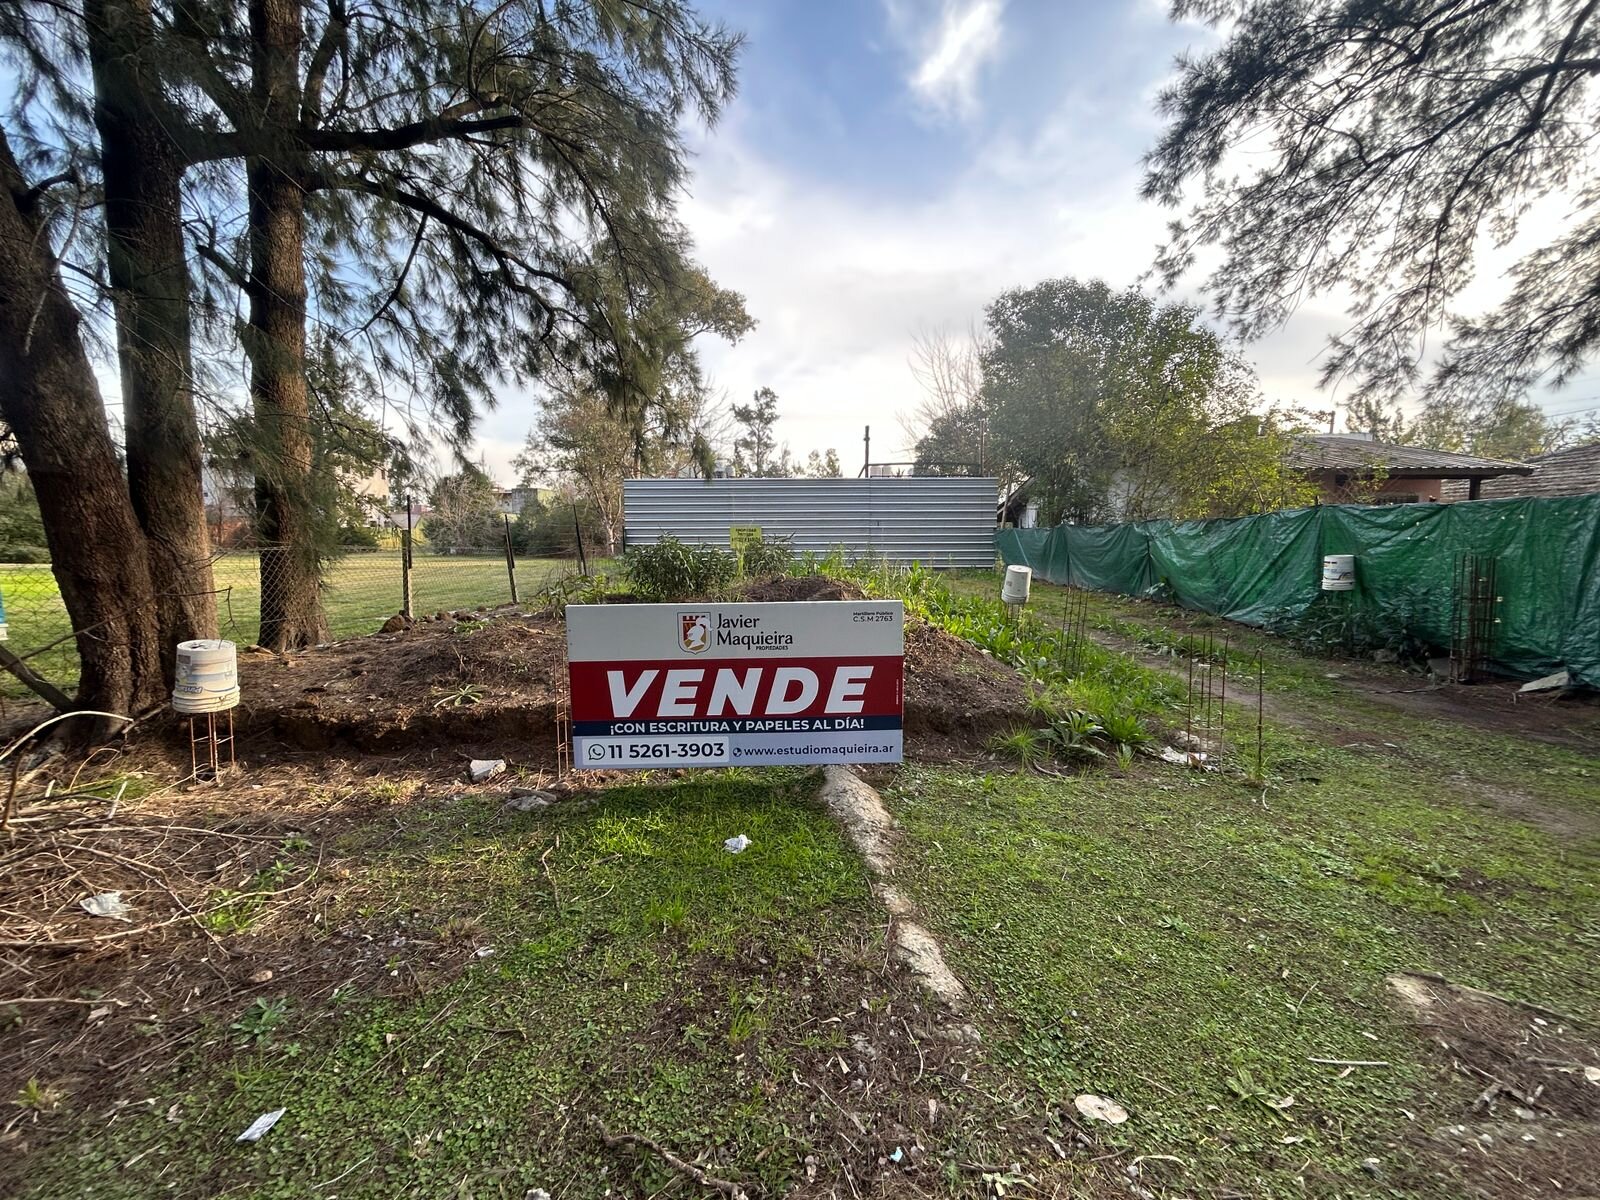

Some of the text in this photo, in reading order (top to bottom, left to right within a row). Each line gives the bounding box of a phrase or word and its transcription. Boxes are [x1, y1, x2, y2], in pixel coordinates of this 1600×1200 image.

[716, 613, 760, 629] Javier
[716, 630, 793, 650] Maquieira
[606, 666, 874, 718] VENDE
[610, 717, 864, 735] ¡CON ESCRITURA Y PAPELES AL DÍA!
[608, 742, 725, 759] 11 5261-3903
[744, 743, 894, 756] www.estudiomaquieira.ar
